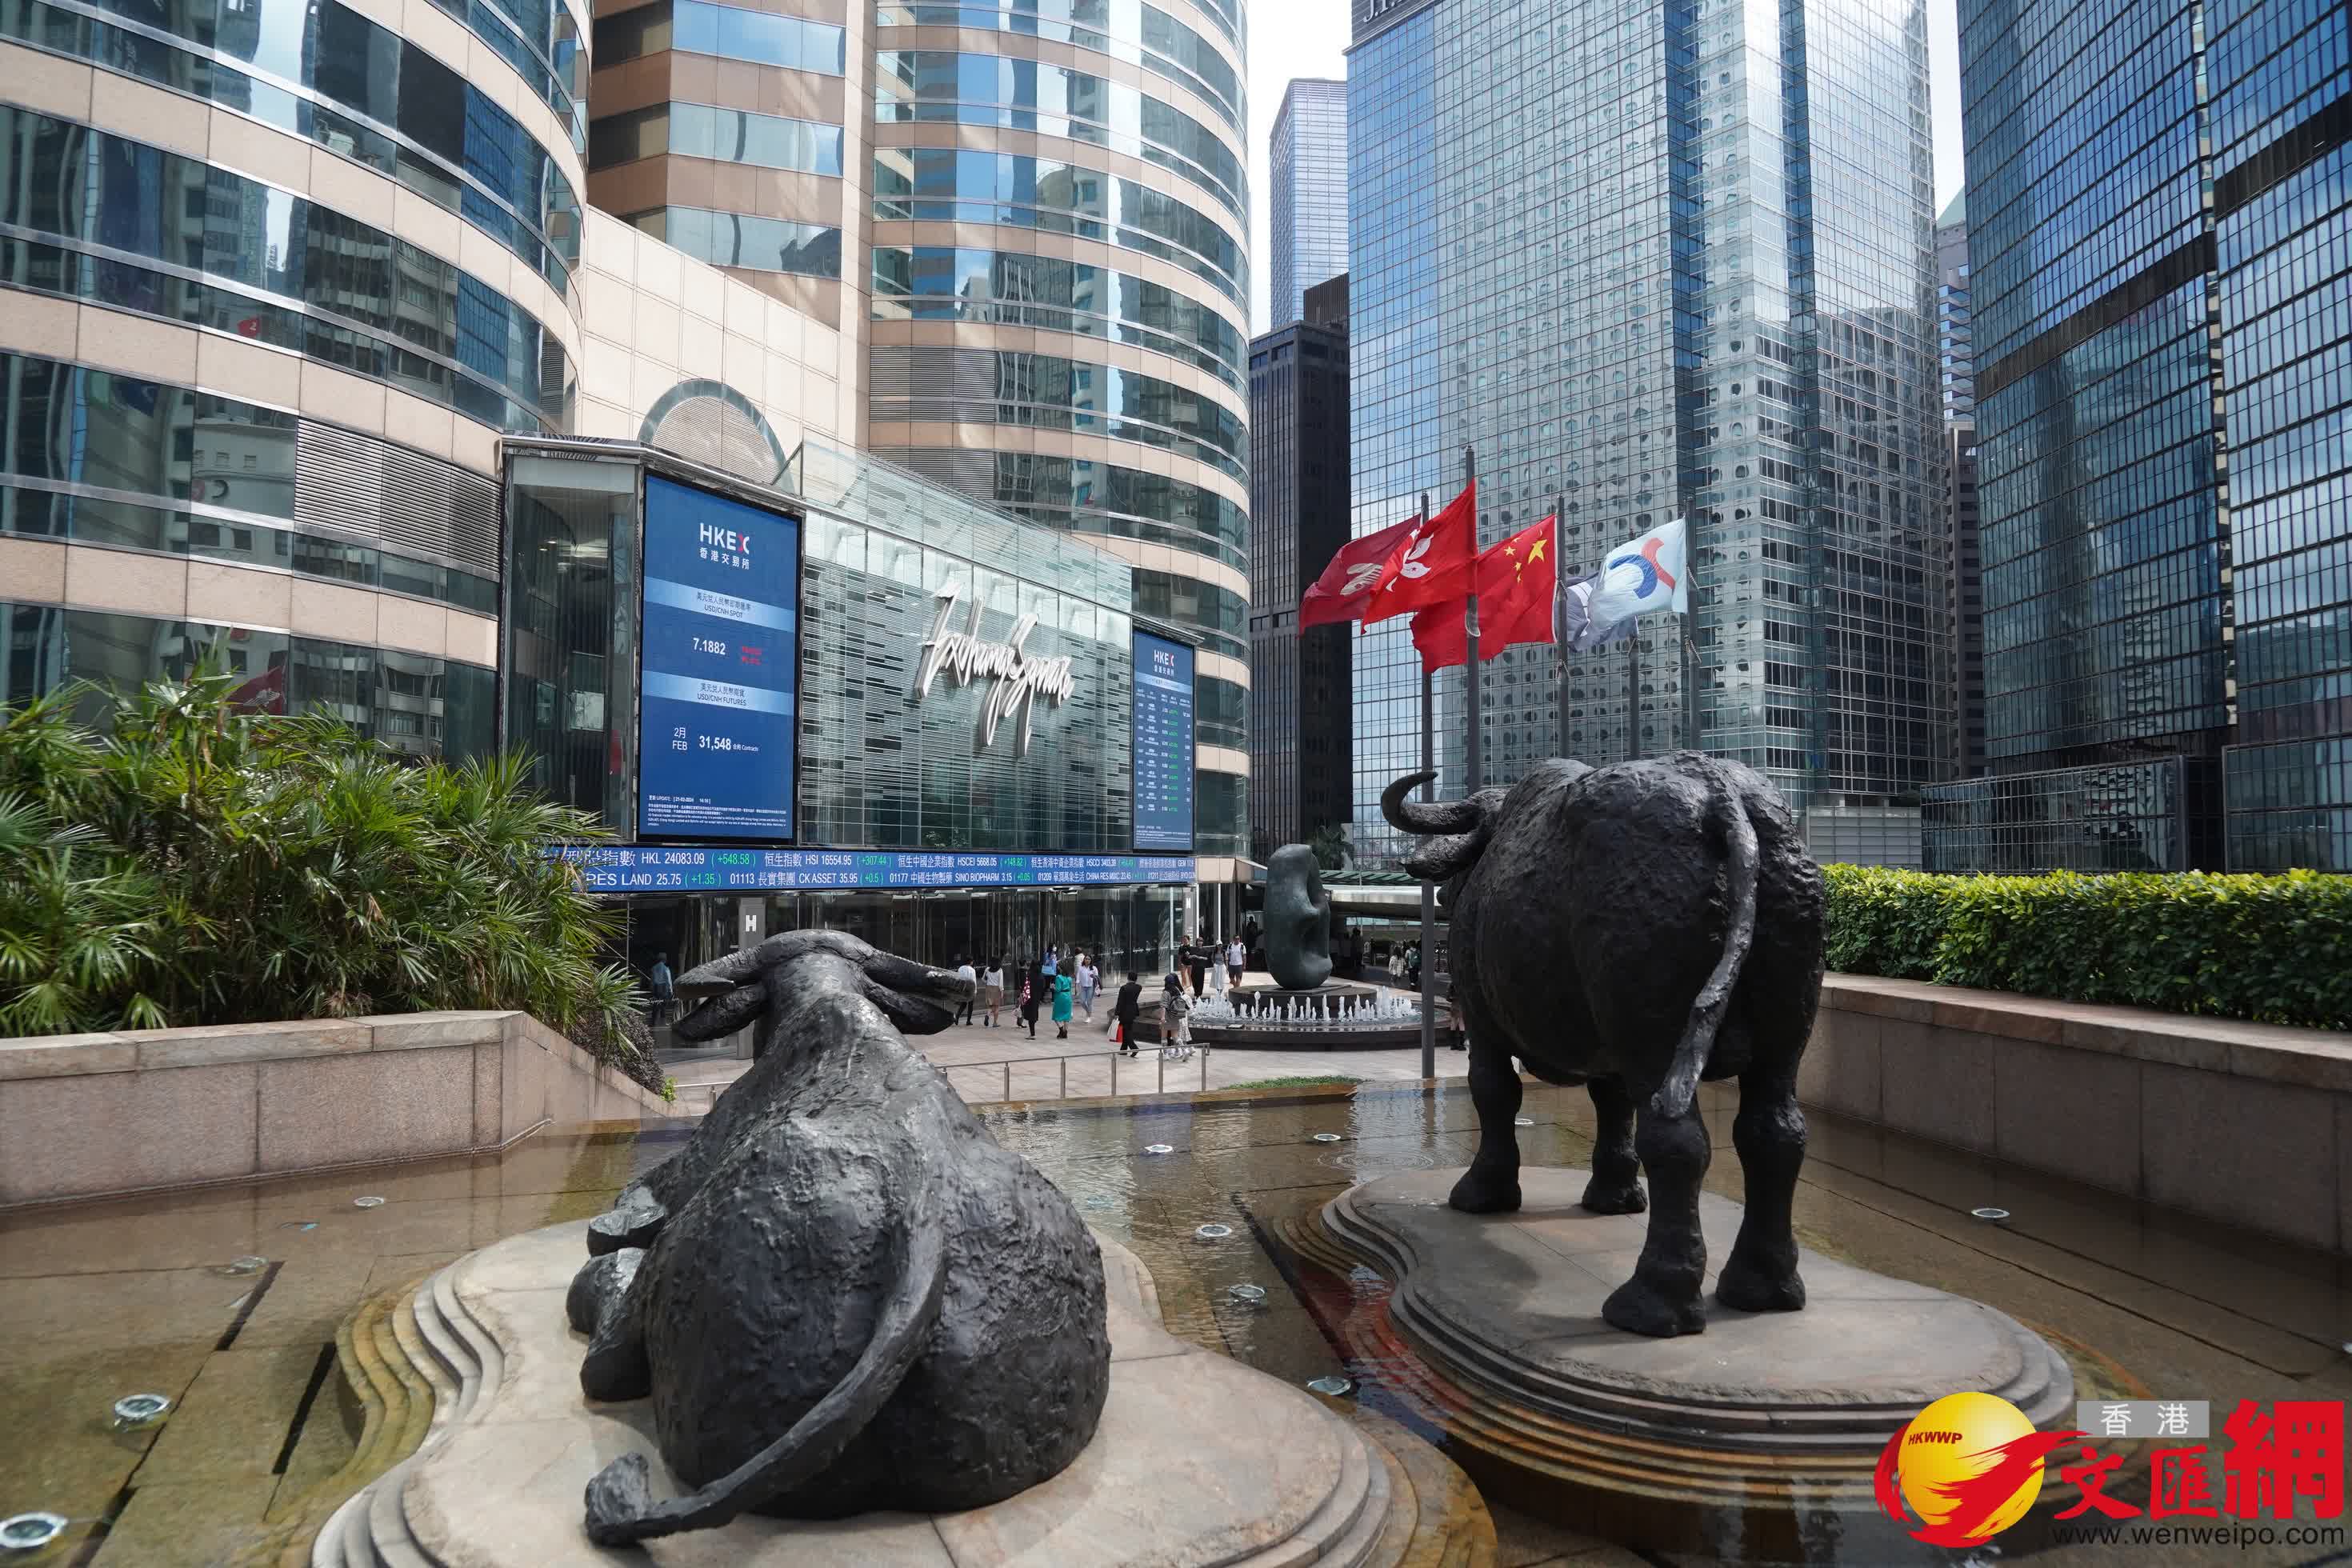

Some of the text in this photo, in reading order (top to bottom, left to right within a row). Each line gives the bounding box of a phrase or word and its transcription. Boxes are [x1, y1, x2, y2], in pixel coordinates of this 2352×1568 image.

[700, 522, 750, 554] HKEX
[700, 547, 750, 570] 香港交易所
[693, 638, 726, 656] 7.1882
[674, 727, 686, 739] 2月
[672, 740, 688, 750] FEB
[699, 735, 731, 751] 31,548
[642, 853, 662, 864] HKL
[665, 853, 705, 865] 24083.09
[805, 855, 818, 866] HSI
[822, 855, 852, 866] 16554.95
[958, 857, 975, 866] HSCEI
[622, 874, 652, 886] LAND
[657, 873, 682, 885] 25.75
[730, 873, 755, 885] 01113
[798, 873, 811, 884] CK
[811, 873, 837, 884] ASSET
[838, 873, 858, 883] 35.95
[889, 873, 909, 883] 01177
[954, 873, 970, 882] SINO
[970, 873, 999, 882] BIOPHARM
[1001, 872, 1013, 882] 3.15
[746, 914, 757, 932] H
